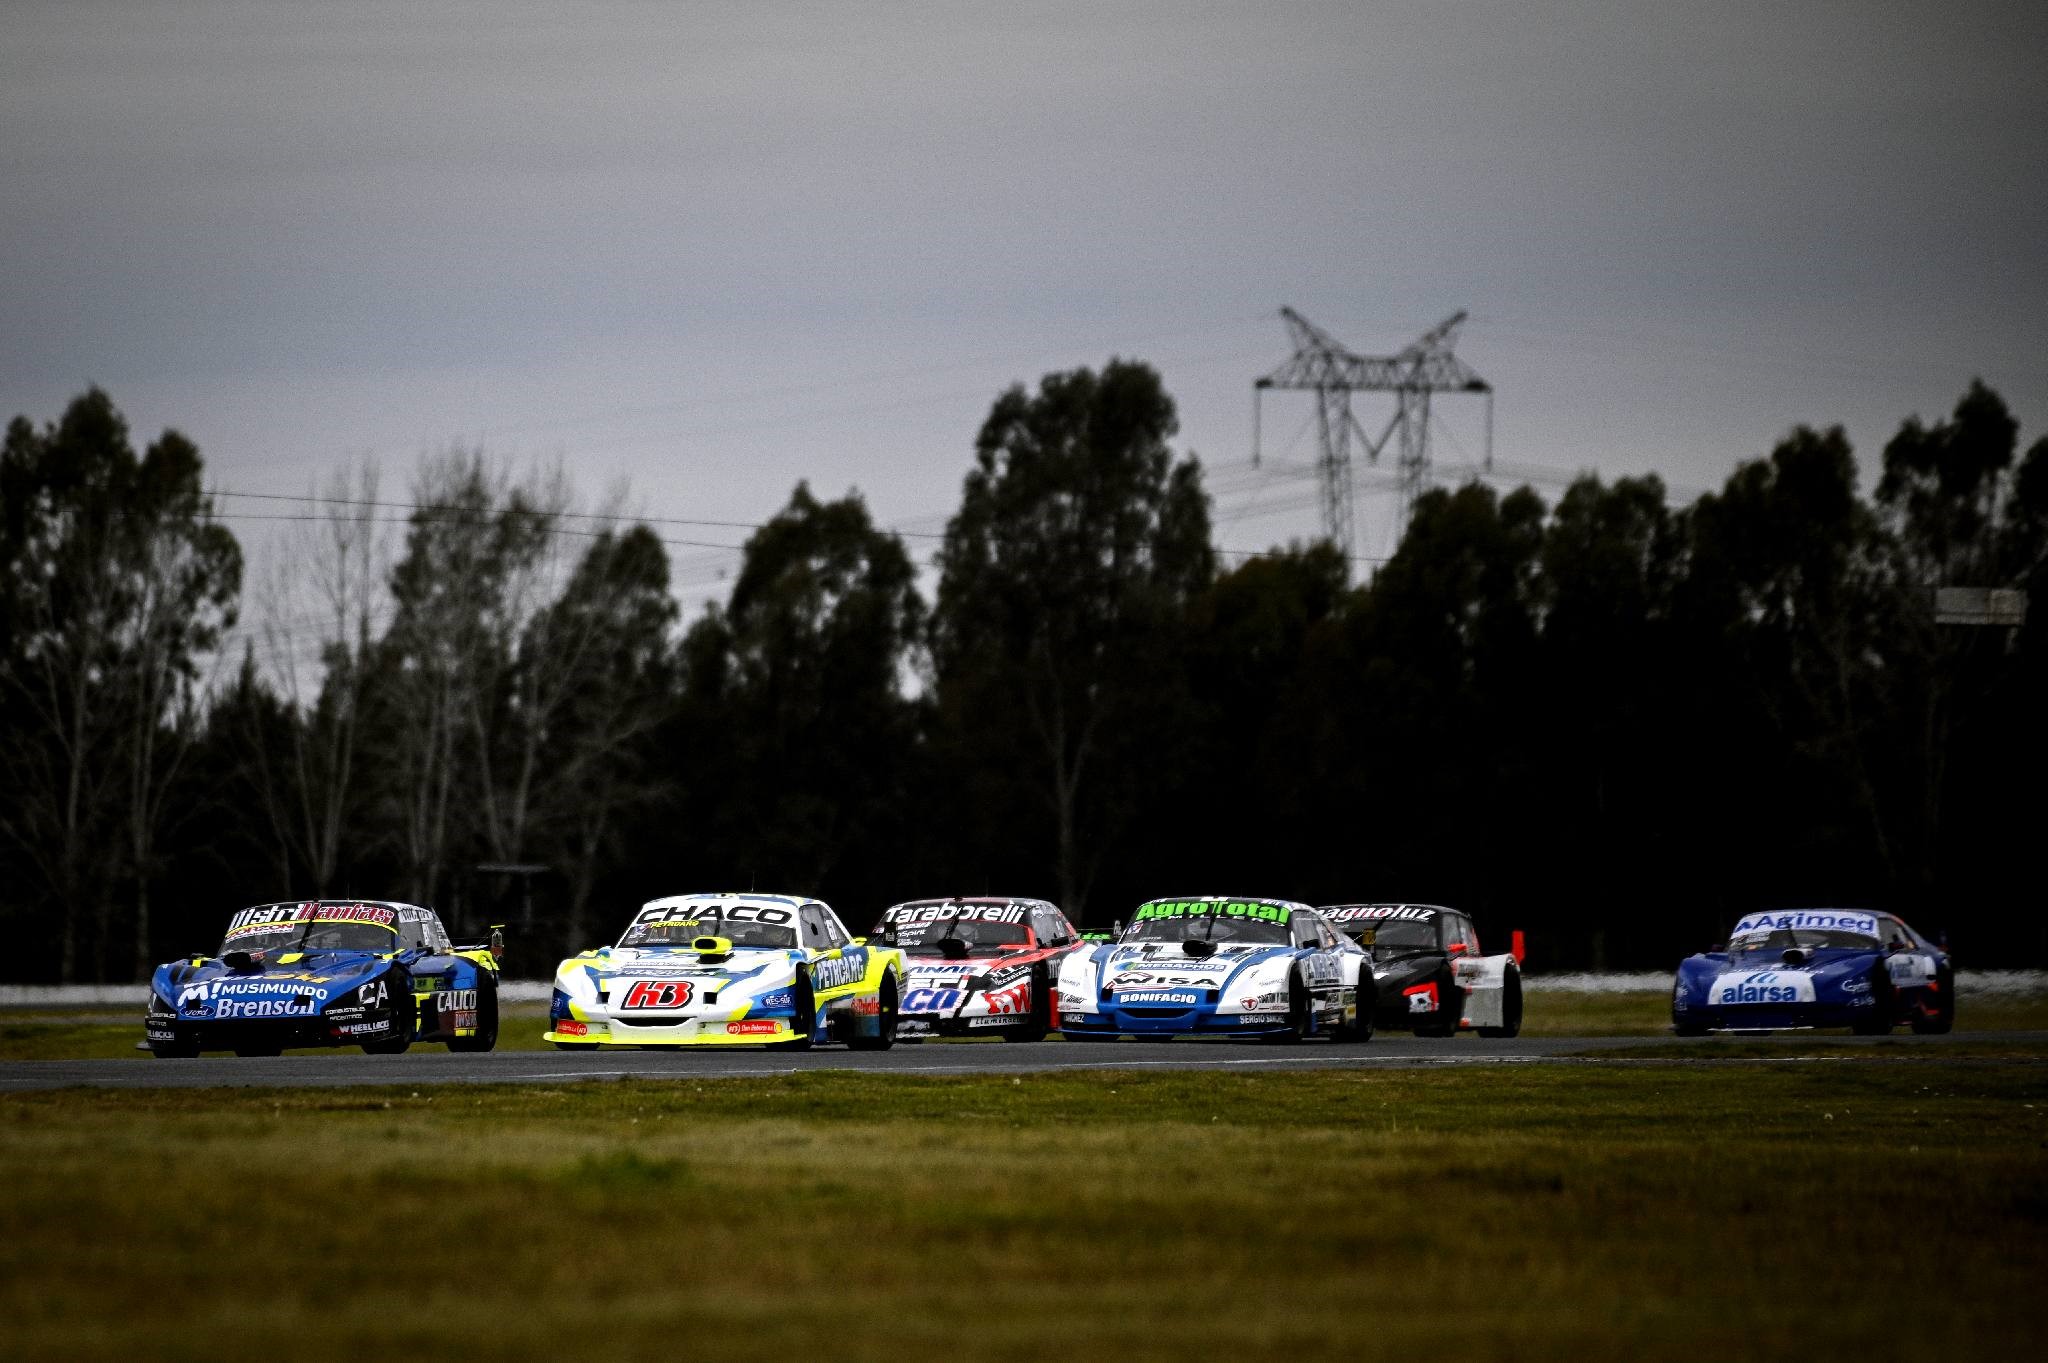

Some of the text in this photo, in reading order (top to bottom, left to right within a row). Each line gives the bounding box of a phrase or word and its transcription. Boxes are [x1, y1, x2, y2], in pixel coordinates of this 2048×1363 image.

[636, 905, 793, 925] CHACO
[886, 902, 1027, 924] Taraborelli
[1135, 901, 1290, 924] AgroTotal
[1318, 905, 1436, 922] agnoluz
[1752, 912, 1874, 931] Agimed
[1112, 976, 1219, 986] WISA
[222, 983, 328, 1000] MUSIMUNDO
[1120, 993, 1197, 1004] BONIFACIO
[1722, 983, 1797, 1003] alarsa
[214, 998, 315, 1018] Brenson
[437, 990, 477, 1013] CALICO
[1239, 1014, 1265, 1025] SERGIO
